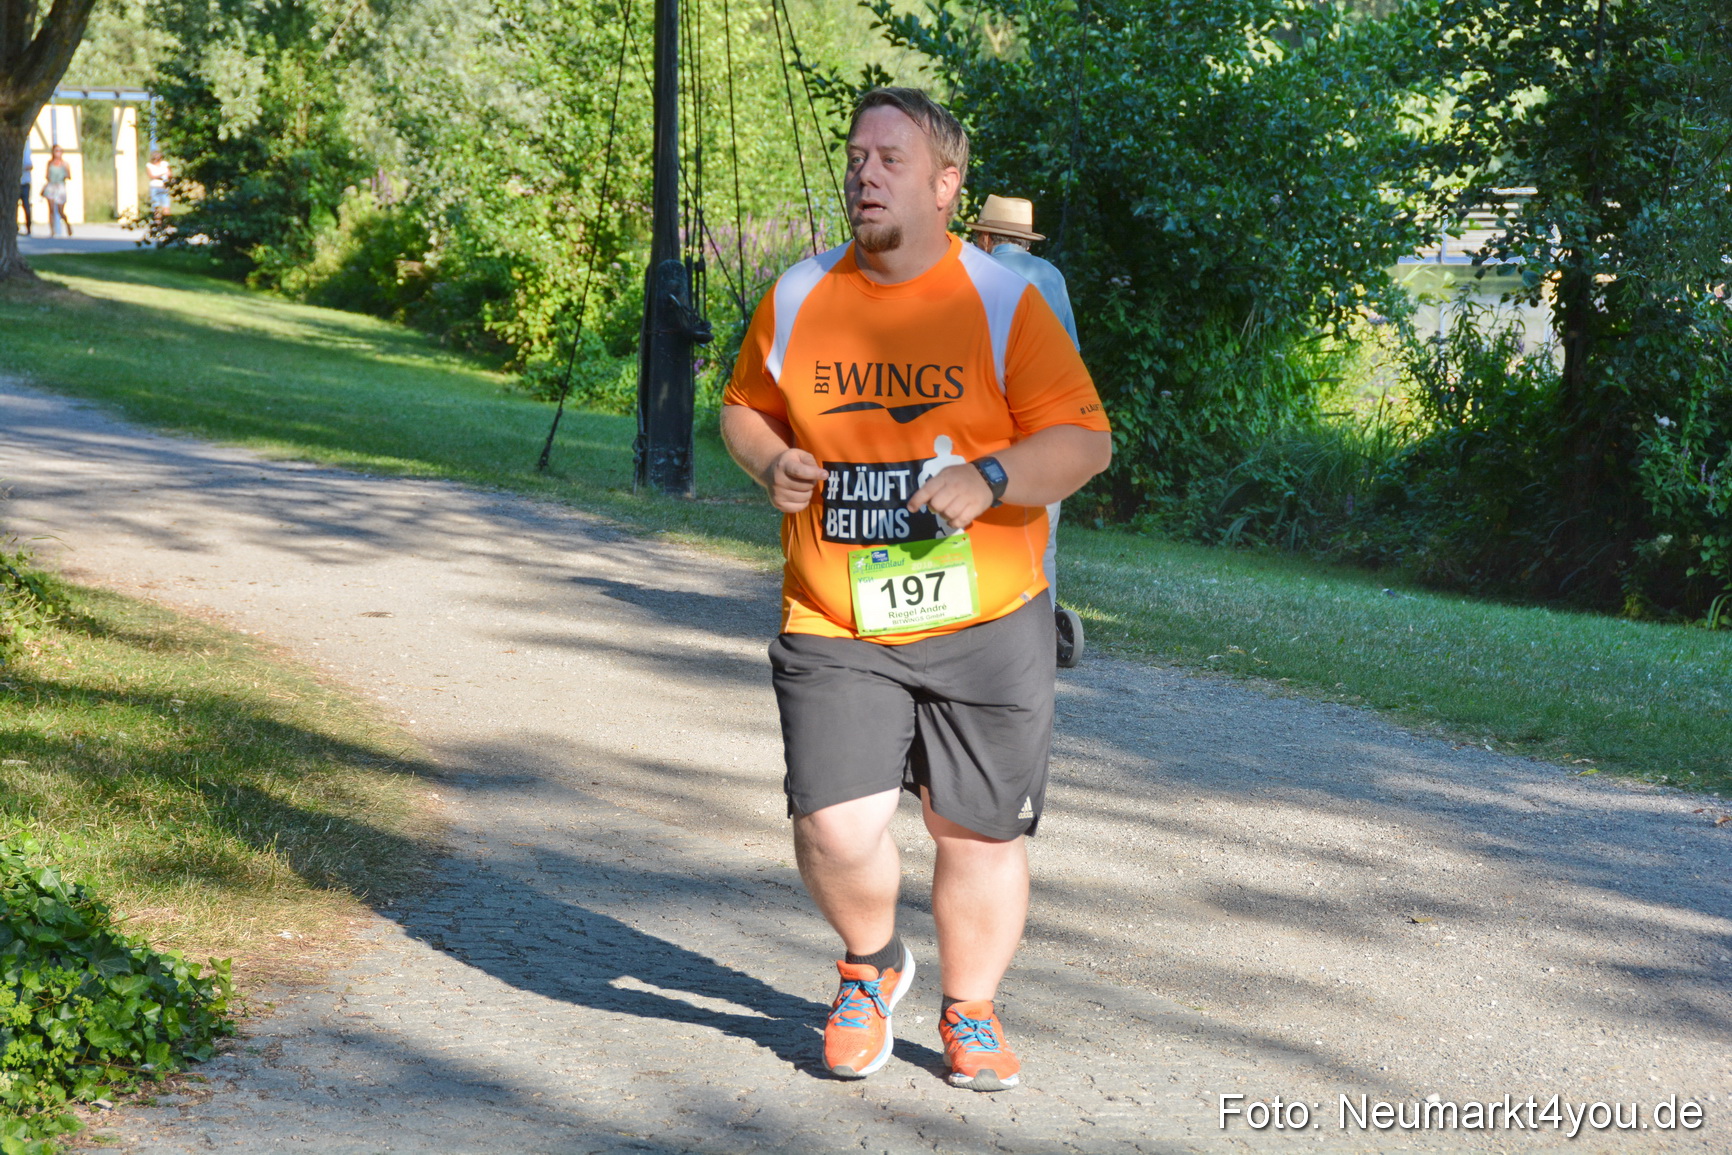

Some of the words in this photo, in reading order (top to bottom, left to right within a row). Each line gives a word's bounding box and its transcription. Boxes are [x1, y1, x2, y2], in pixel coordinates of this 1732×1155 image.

[814, 361, 831, 394] BIT
[833, 362, 964, 399] WINGS
[827, 466, 910, 501] #LÄUFT
[826, 507, 856, 538] BEI
[862, 508, 910, 539] UNS
[865, 558, 905, 571] firmenlauf
[881, 571, 946, 608] 197
[888, 608, 917, 619] Riegel
[892, 616, 924, 625] BITWINGS
[926, 612, 945, 620] GmbH
